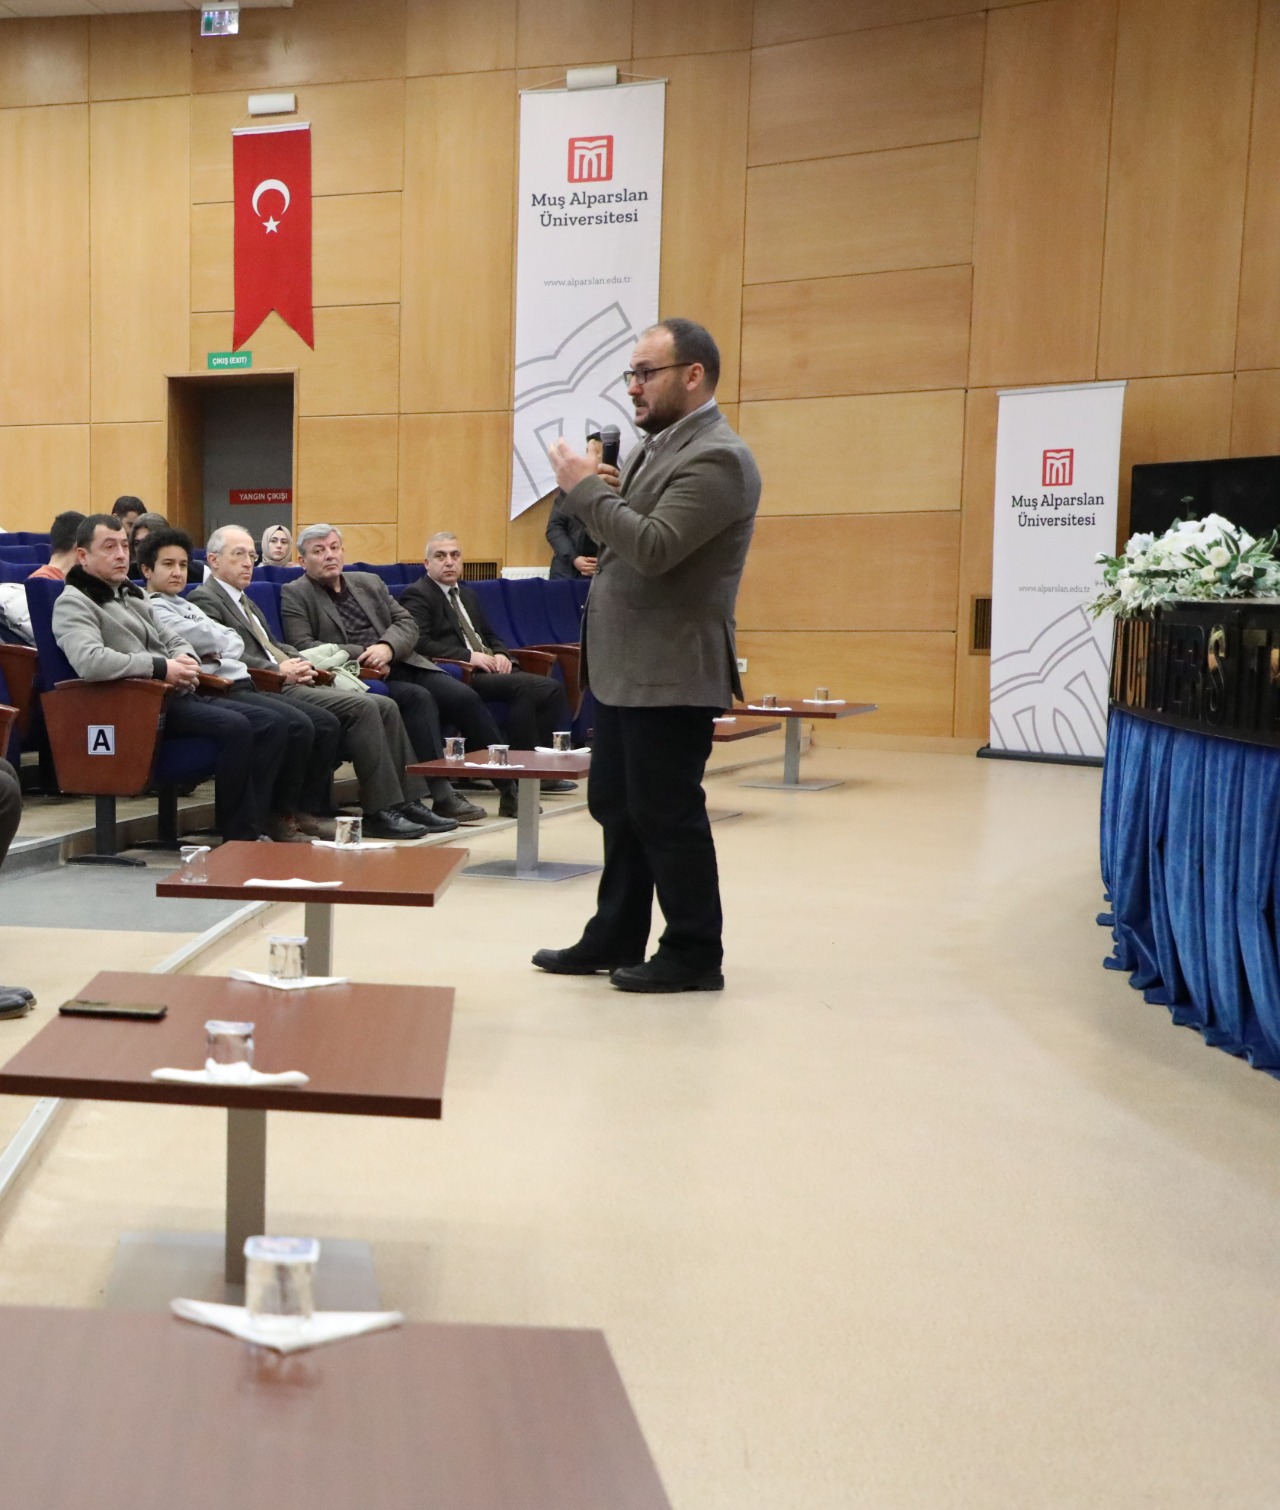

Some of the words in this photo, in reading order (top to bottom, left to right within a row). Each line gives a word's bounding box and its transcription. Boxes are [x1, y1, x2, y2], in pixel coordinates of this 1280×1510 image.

[531, 193, 566, 209] Muş
[570, 188, 649, 208] Alparslan
[540, 209, 639, 227] Üniversitesi
[544, 276, 631, 288] www.alparslan.edu.tr
[212, 357, 229, 366] ÇIKIŞ
[230, 356, 247, 364] (EXIT)
[239, 493, 265, 501] YANGIN
[267, 492, 288, 501] ÇIKIŞI
[1011, 495, 1038, 510] Muş
[1040, 492, 1105, 510] Alparslan
[1018, 512, 1096, 527] Üniversitesi
[1018, 584, 1091, 594] www.alparslan.edu.tr
[93, 729, 110, 751] A
